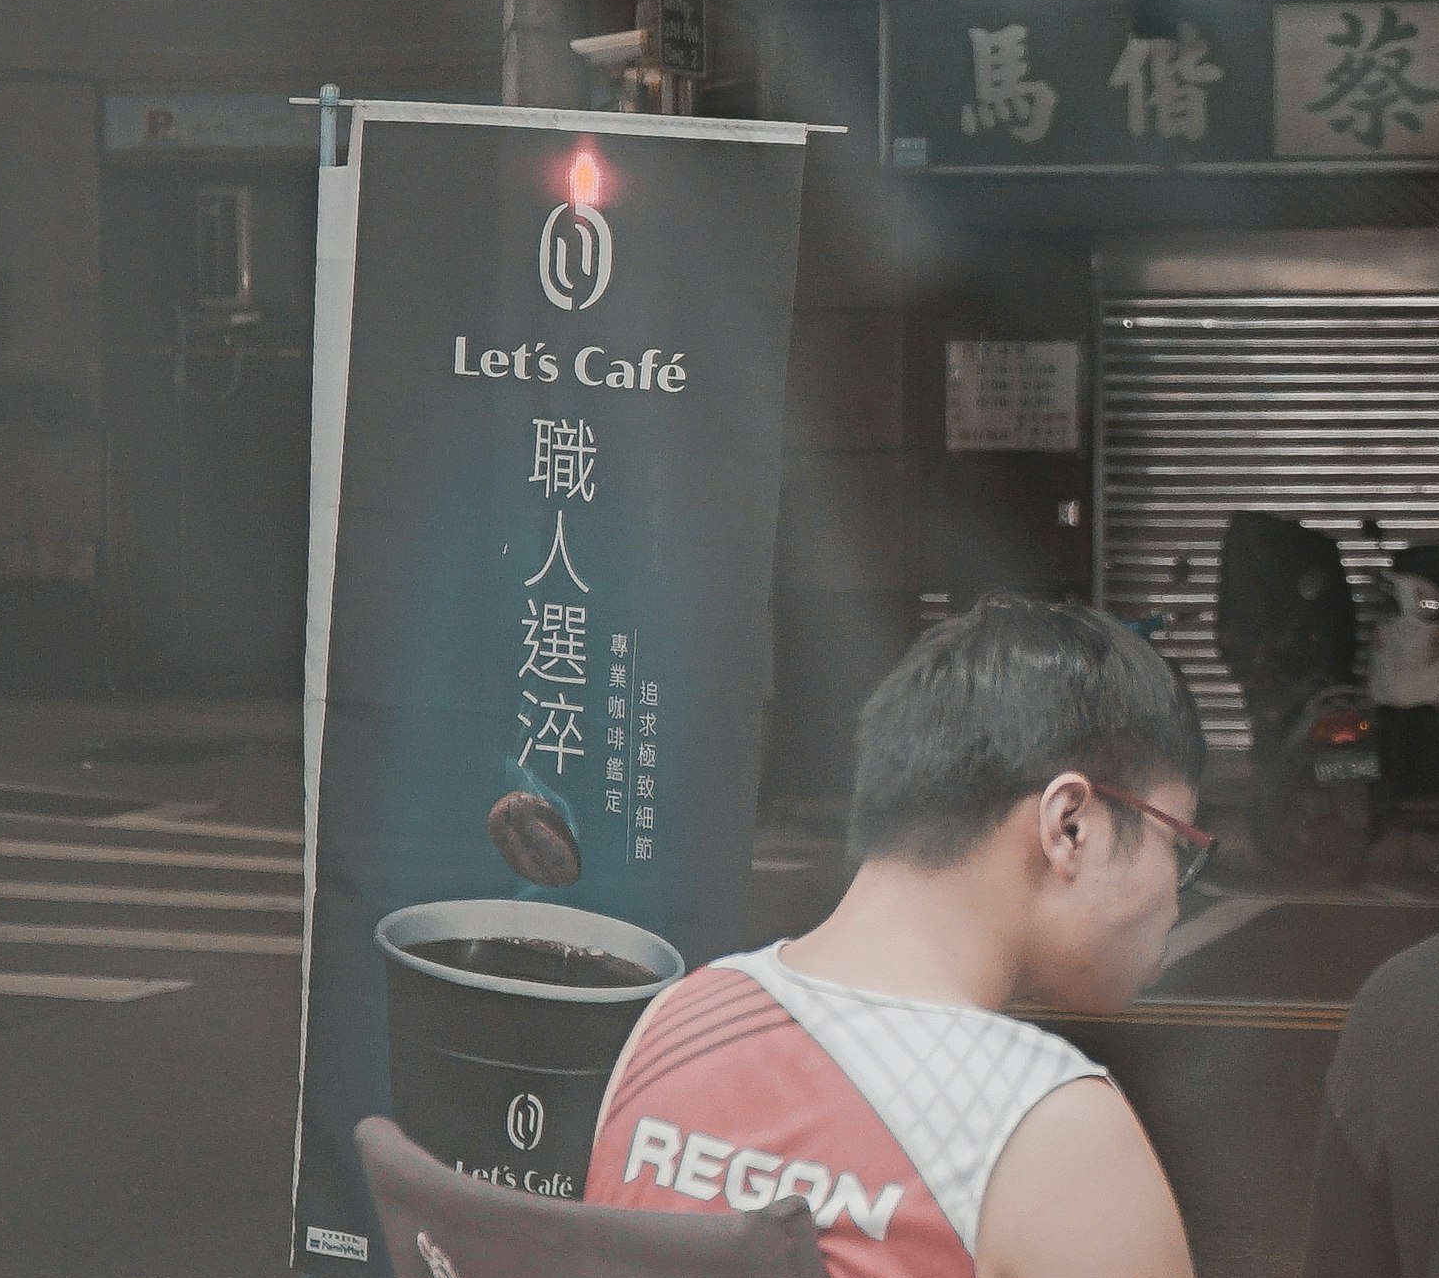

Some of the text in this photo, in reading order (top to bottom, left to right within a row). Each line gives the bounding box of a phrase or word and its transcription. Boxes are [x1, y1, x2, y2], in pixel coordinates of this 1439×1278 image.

[959, 22, 1224, 144] 馬偕
[454, 336, 688, 394] Let's Café
[516, 418, 598, 776] 職人選淬
[604, 632, 630, 815] 專業咖啡鑑定
[634, 679, 659, 861] 追求極致細節
[523, 1169, 575, 1198] Café
